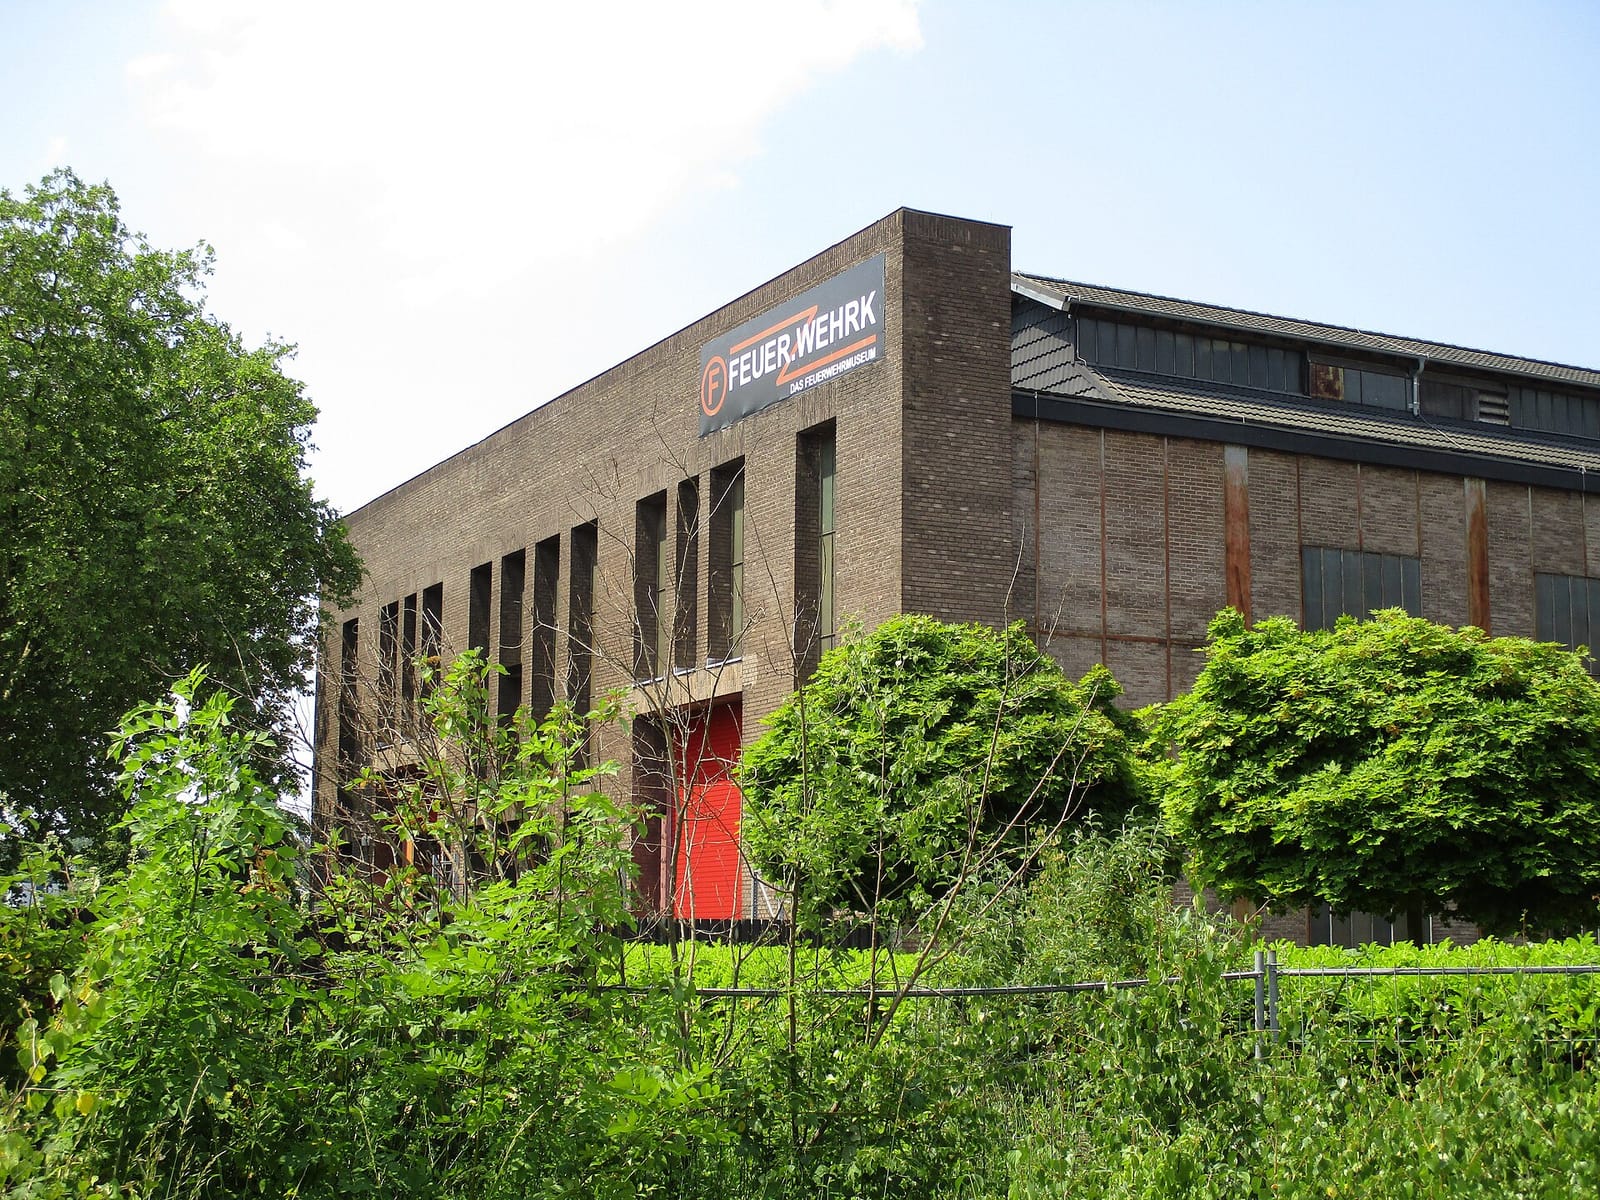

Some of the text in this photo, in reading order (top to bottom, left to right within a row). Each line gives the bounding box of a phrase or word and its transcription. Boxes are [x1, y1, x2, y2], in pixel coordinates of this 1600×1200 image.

[708, 367, 720, 406] F
[790, 347, 876, 394] DAS FEUERWEHRMUSEUM
